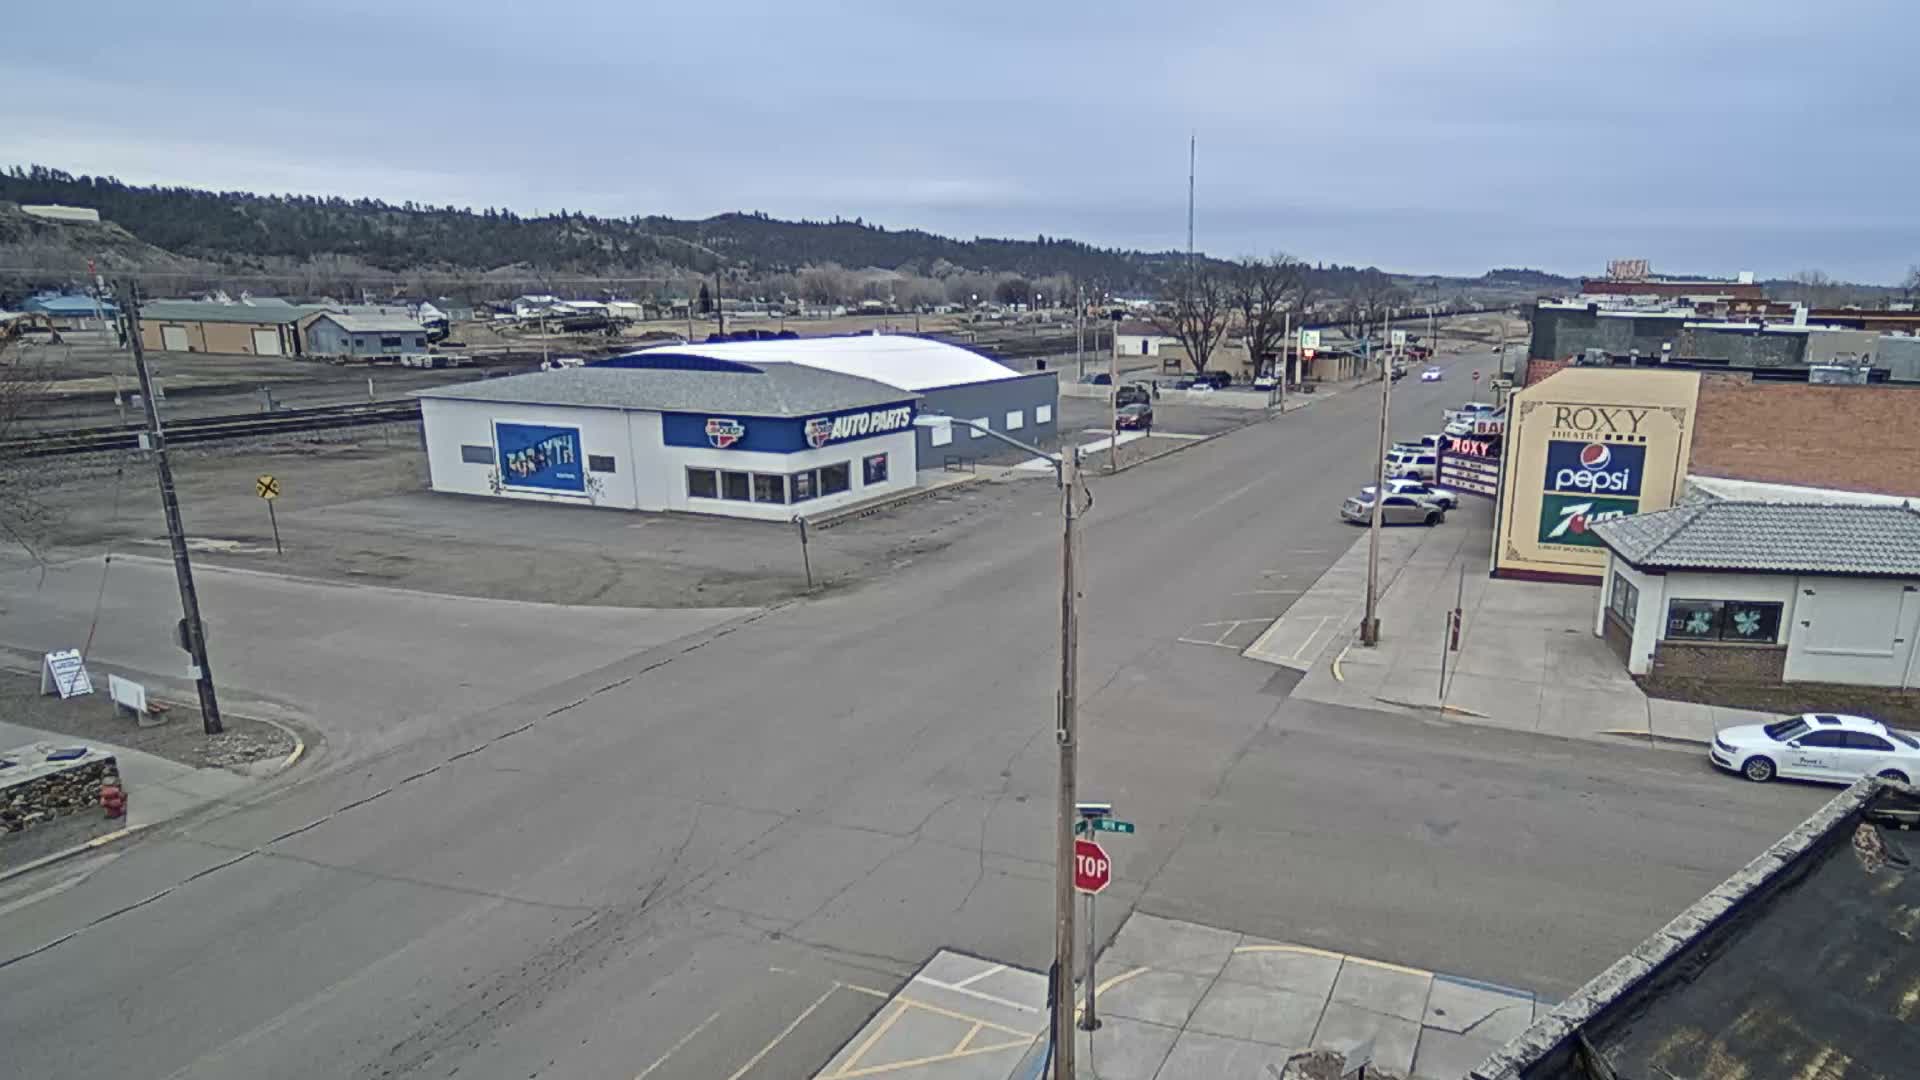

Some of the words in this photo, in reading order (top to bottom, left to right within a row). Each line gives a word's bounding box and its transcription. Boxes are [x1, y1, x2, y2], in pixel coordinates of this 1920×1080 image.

[830, 412, 870, 439] AUTO
[869, 406, 912, 433] PARTS
[1552, 407, 1649, 433] ROXY
[1451, 437, 1489, 456] ROXY
[1555, 468, 1630, 493] pepsi
[1076, 855, 1108, 878] TOP
